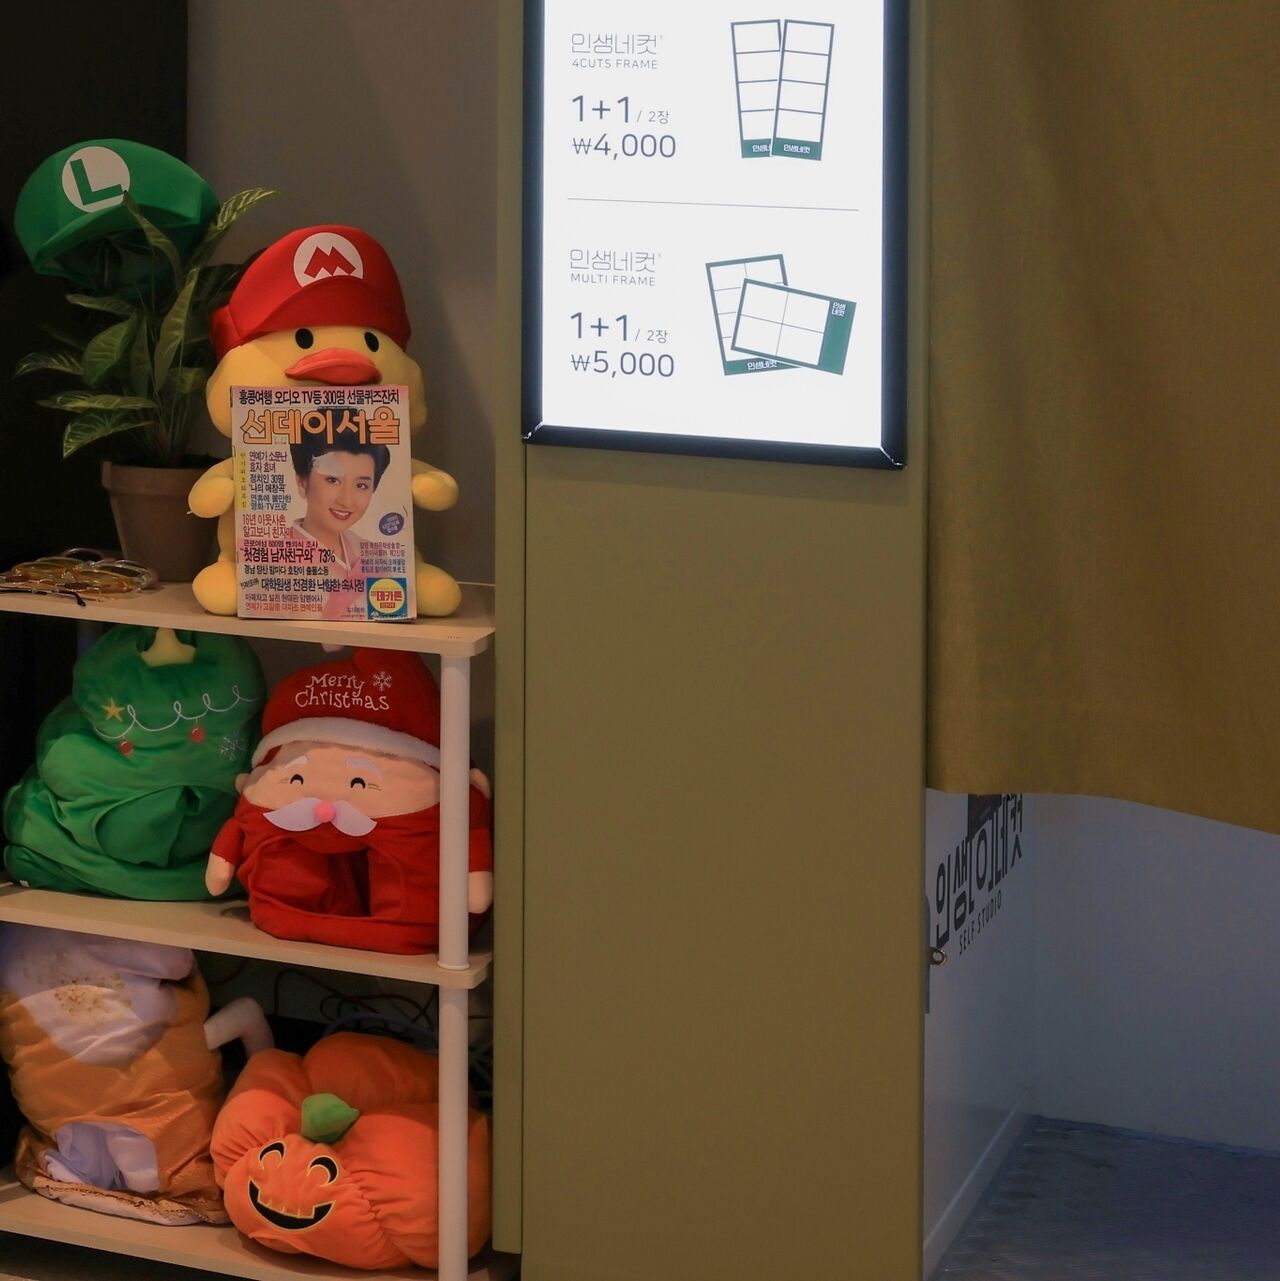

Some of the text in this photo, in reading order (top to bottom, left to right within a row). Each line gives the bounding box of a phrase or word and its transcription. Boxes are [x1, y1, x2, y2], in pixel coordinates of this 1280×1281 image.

[571, 32, 658, 55] 인생네컷
[572, 58, 658, 70] 4CUTS FRAME
[571, 133, 677, 161] ₩4,000
[70, 158, 127, 207] L
[304, 245, 357, 279] M
[570, 249, 656, 273] 인생네컷
[571, 272, 656, 287] MULTI FRAME
[570, 350, 675, 378] ₩5,000
[239, 389, 400, 405] 홍콩여행 오디오 TV등 300명 선물퀴즈잔치
[318, 548, 336, 564] 73%
[305, 673, 365, 698] Merry
[295, 687, 390, 711] Christmas
[959, 888, 1002, 956] SELF STUDIO
